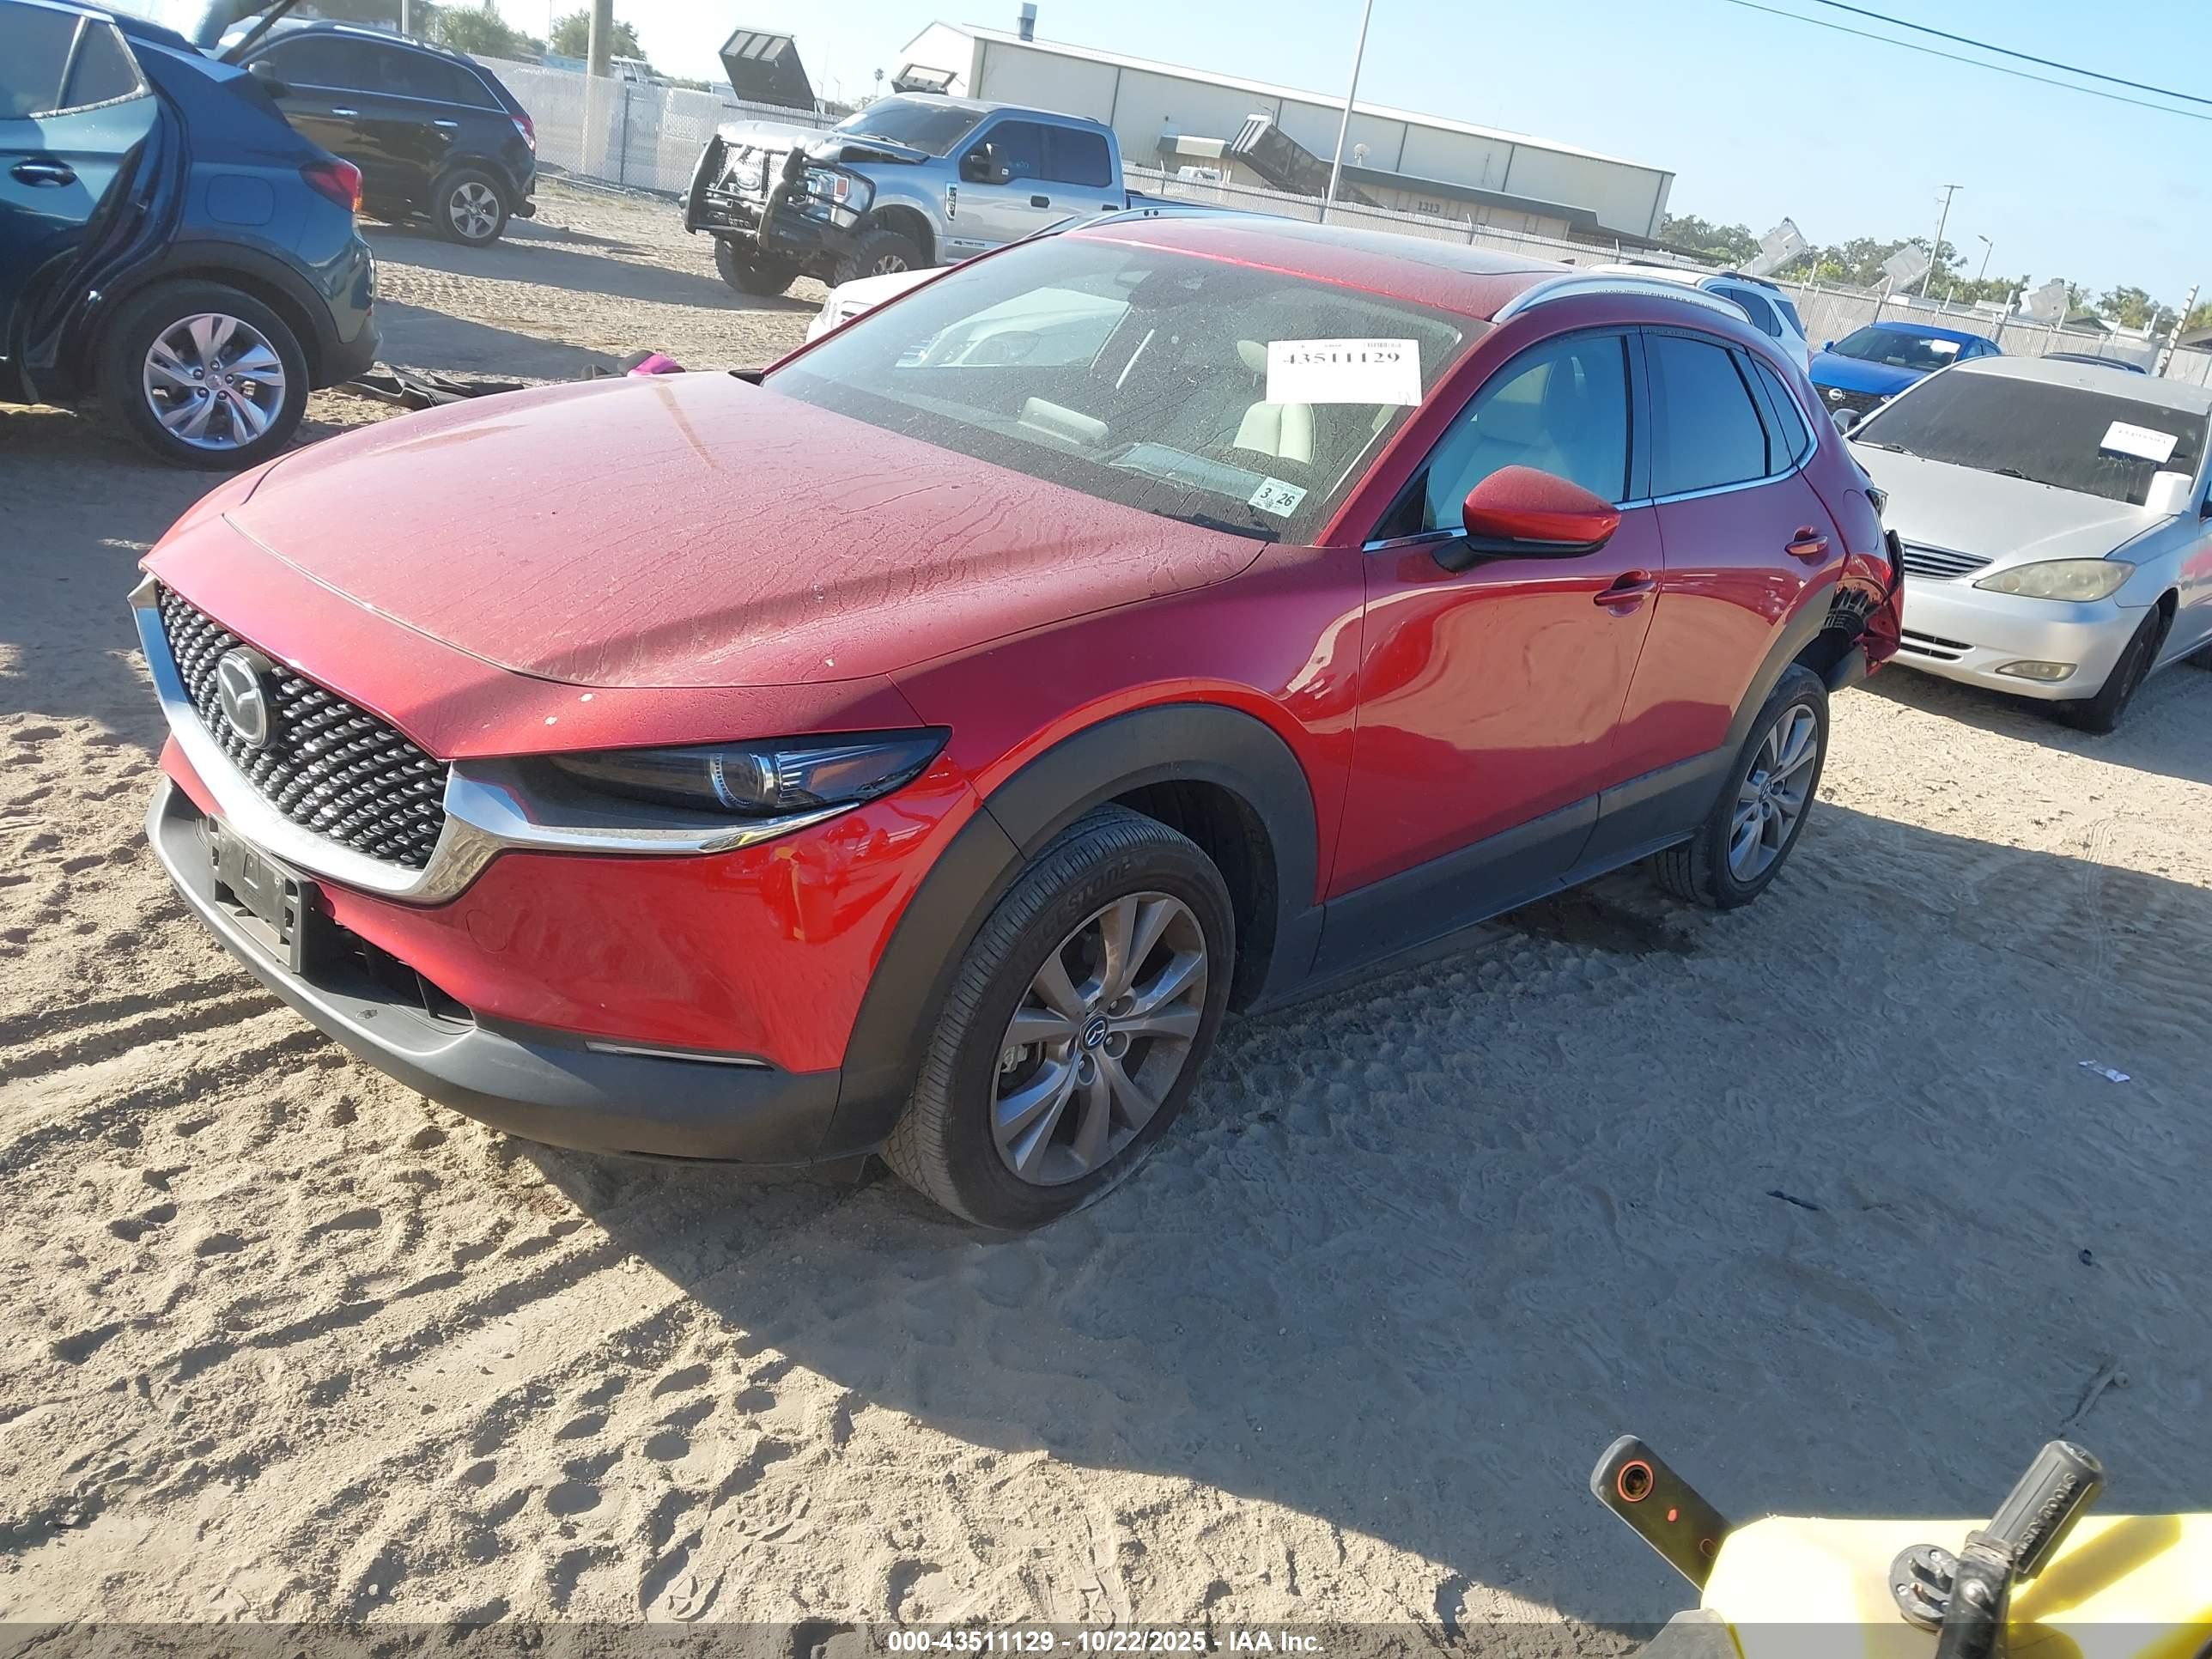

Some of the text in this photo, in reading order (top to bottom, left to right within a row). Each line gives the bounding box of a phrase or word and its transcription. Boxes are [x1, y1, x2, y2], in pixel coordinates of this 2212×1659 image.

[1418, 201, 1440, 214] 1313
[1283, 352, 1401, 364] 43511129
[1260, 487, 1273, 499] 3
[1276, 493, 1295, 507] 26
[2038, 1473, 2076, 1519] TOOLS
